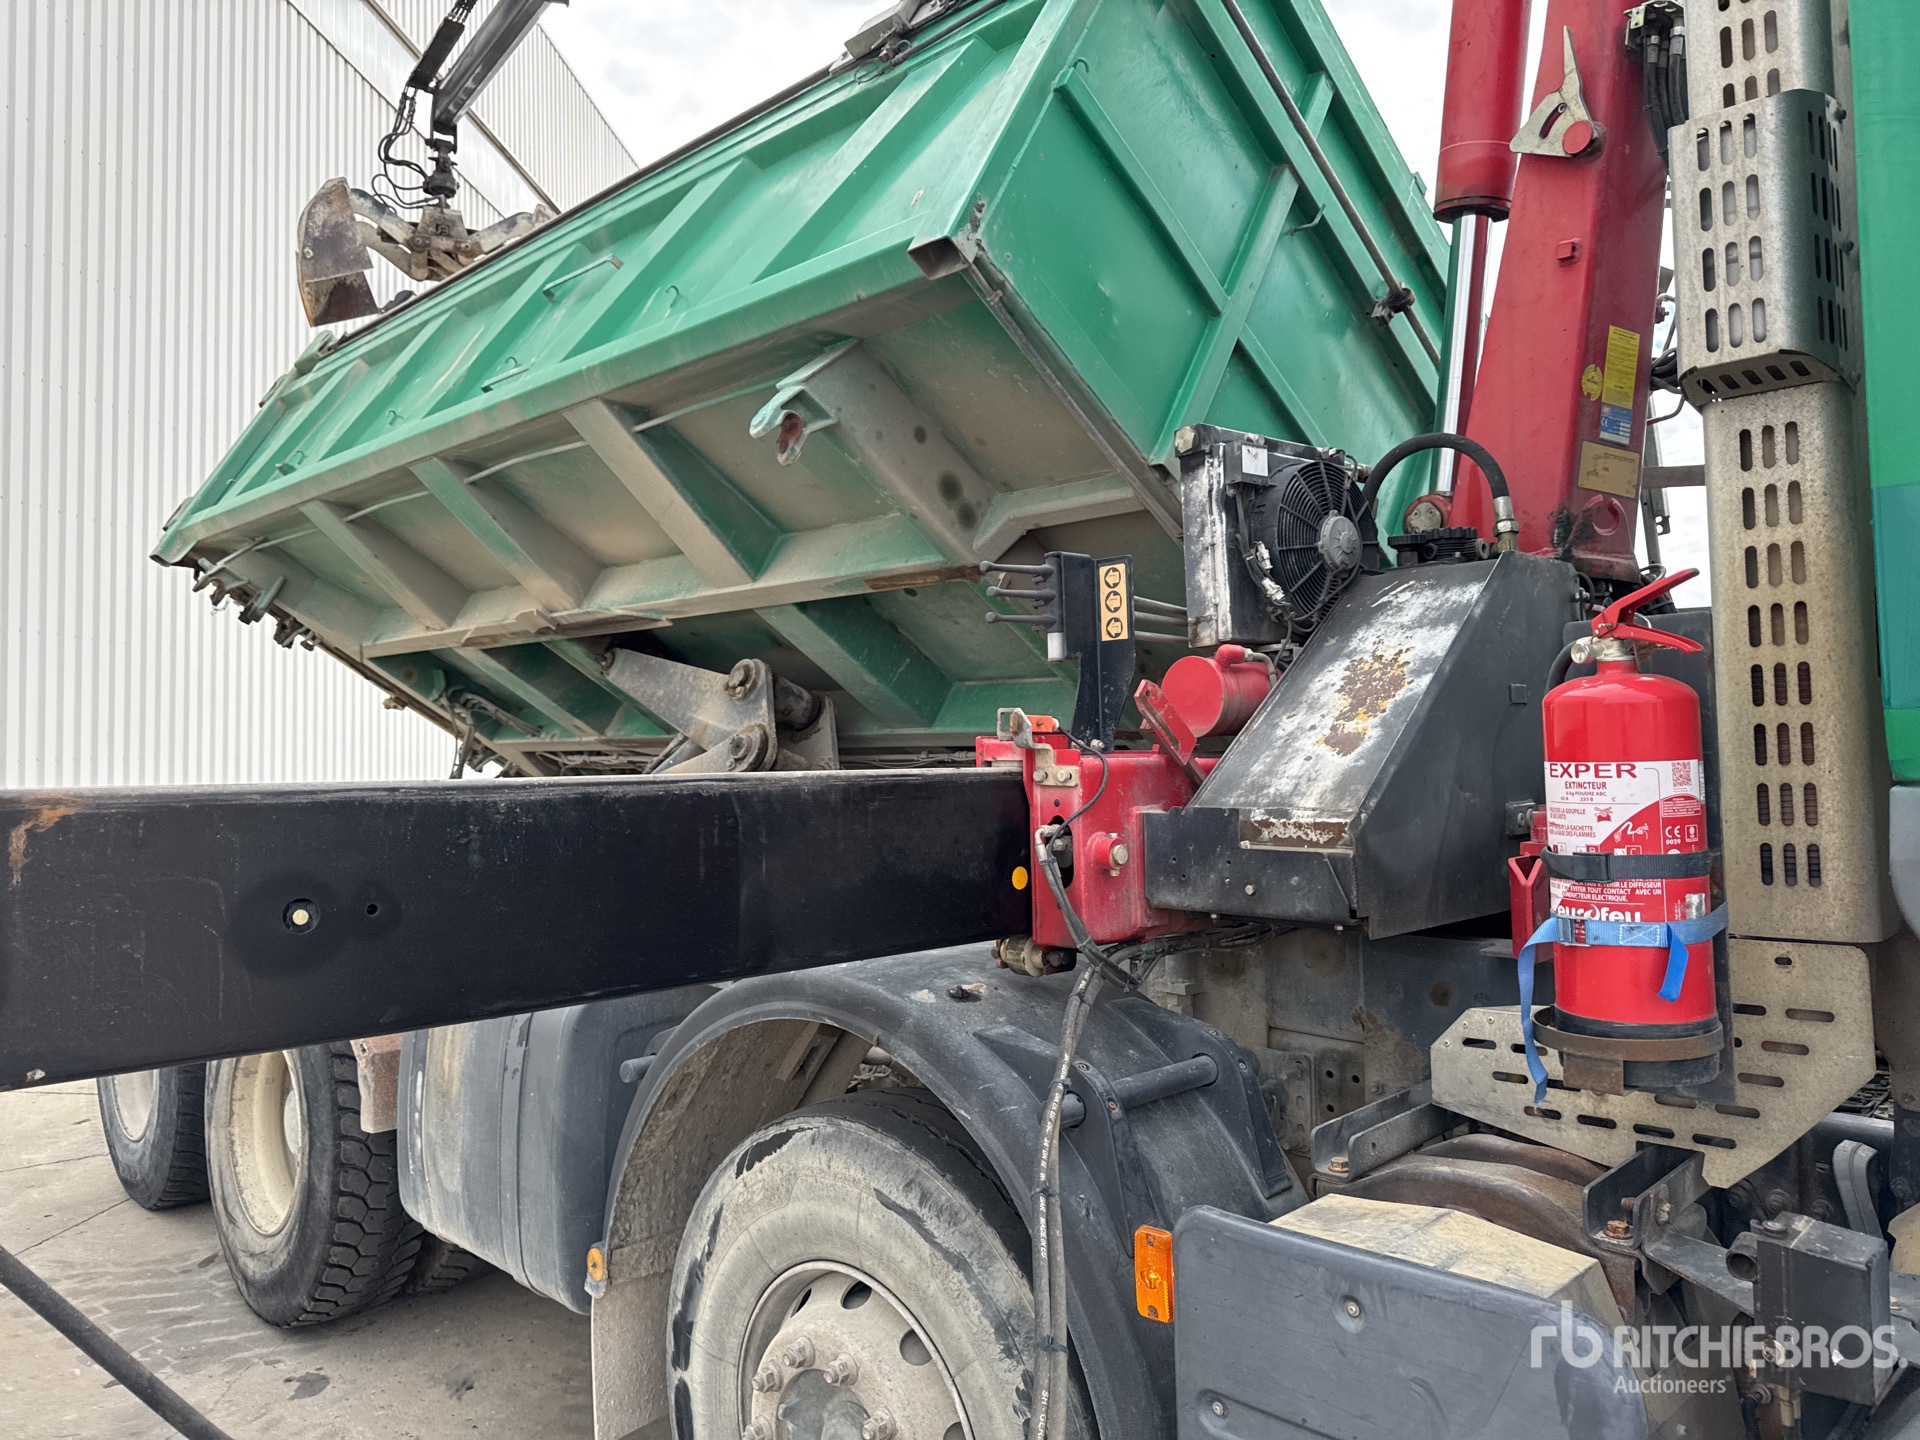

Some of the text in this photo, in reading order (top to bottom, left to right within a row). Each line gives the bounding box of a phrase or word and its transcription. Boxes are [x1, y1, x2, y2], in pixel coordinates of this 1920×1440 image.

[1550, 763, 1637, 779] EXPER
[1565, 781, 1607, 790] EXTINCTEUR
[1665, 825, 1681, 839] CE
[1628, 881, 1662, 889] DIFFUSEUR
[1591, 893, 1628, 902] ELECTRIQUE.
[1039, 1217, 1047, 1238] MADE
